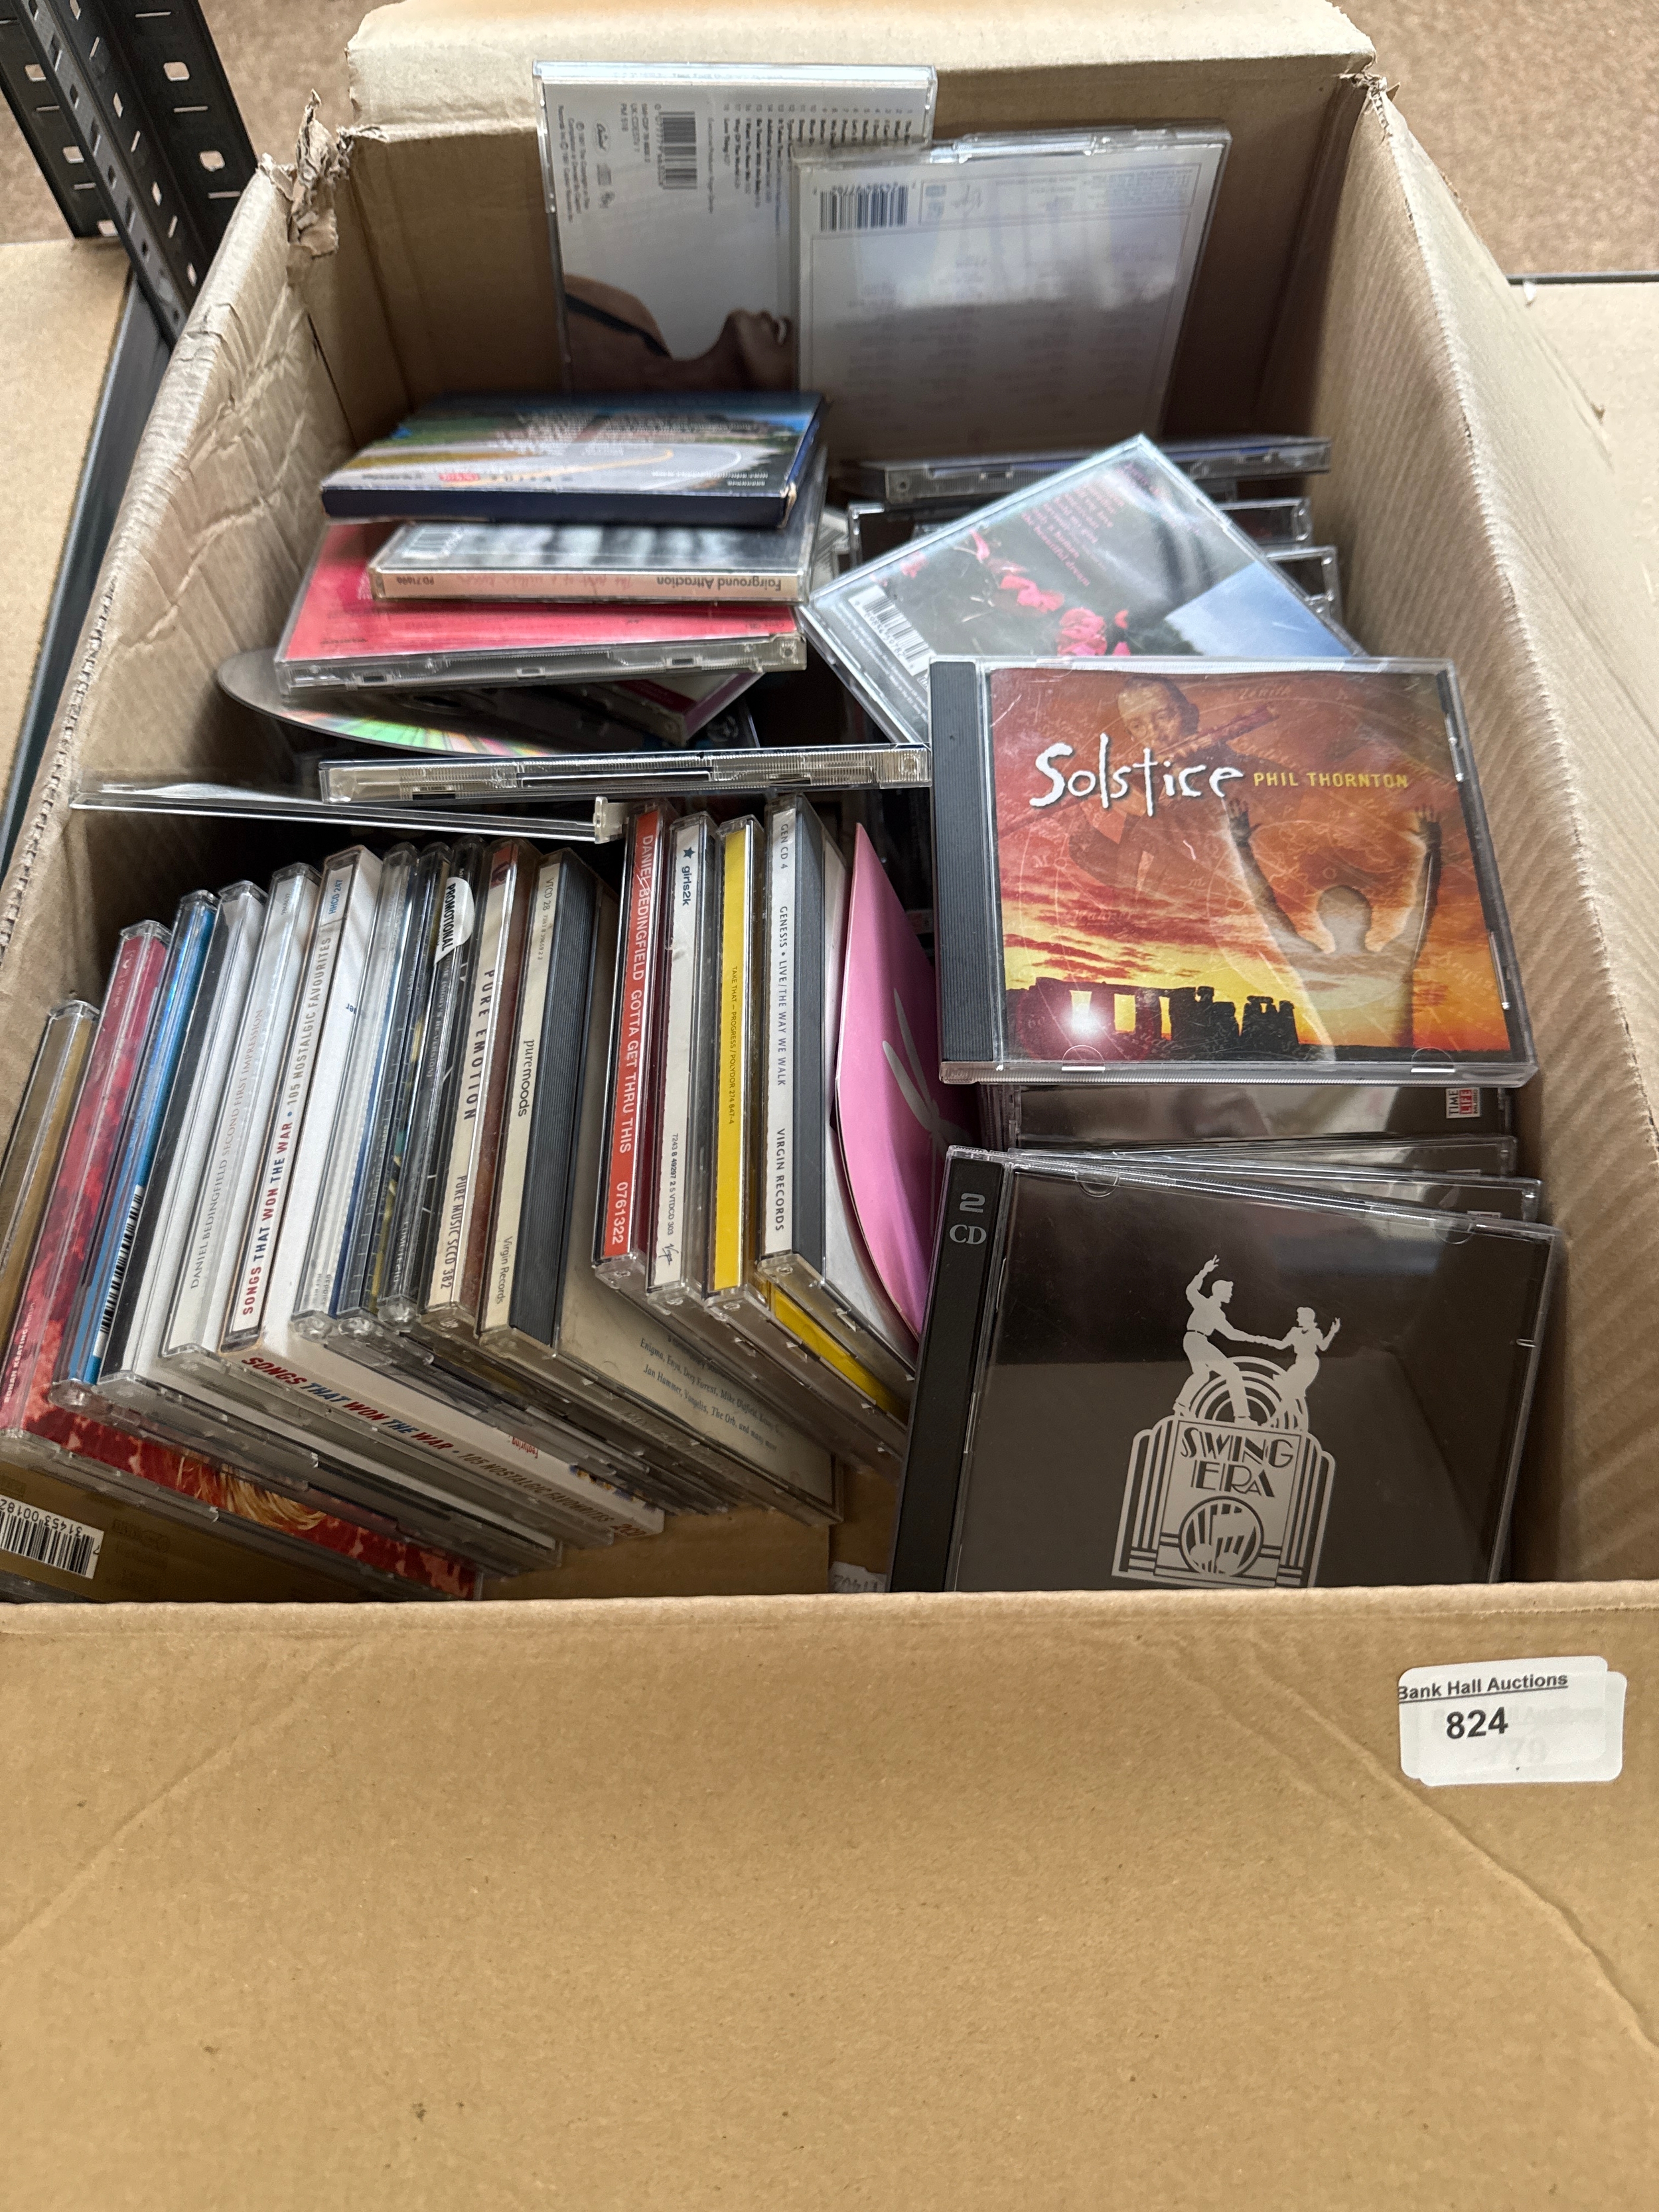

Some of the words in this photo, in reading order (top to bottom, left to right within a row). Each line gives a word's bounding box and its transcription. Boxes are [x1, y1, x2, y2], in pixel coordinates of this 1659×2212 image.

[656, 576, 713, 589] Attraction
[717, 575, 782, 591] Fairground
[1030, 732, 1245, 818] Solstice
[1254, 773, 1299, 787] PHIL
[1306, 773, 1409, 788] THORNTON
[640, 834, 654, 881] DANIEL
[780, 847, 788, 859] CD
[328, 893, 340, 915] HHCD
[334, 879, 343, 893] 247
[543, 877, 555, 899] VTCD
[682, 865, 693, 906] girls2k
[441, 883, 456, 952] PROMOTIONAL
[543, 899, 551, 911] 28
[632, 888, 652, 981] BEDINGFIELD
[779, 906, 788, 948] GENESIS
[308, 937, 332, 1010] FAVOURITES
[478, 969, 496, 1017] PURE
[628, 989, 642, 1037] GOTTA
[778, 1011, 786, 1034] WAY
[293, 1011, 316, 1080] NOSTALGIC
[626, 1039, 639, 1068] GET
[778, 1037, 786, 1053] WE
[464, 1029, 488, 1120] EMOTION
[518, 1039, 536, 1118] puremoods
[777, 1057, 786, 1086] WALK
[287, 1083, 301, 1106] 105
[622, 1072, 636, 1114] THRU
[1448, 1090, 1459, 1116] TIME
[1461, 1090, 1472, 1113] LIFE
[190, 1241, 208, 1290] DANIEL
[202, 1159, 228, 1240] BEDINGFIELD
[222, 1108, 240, 1156] SECOND
[234, 1077, 248, 1107] FIRST
[242, 1009, 263, 1074] IMPRESSION
[276, 1122, 293, 1155] WAR
[619, 1117, 634, 1153] THIS
[776, 1128, 786, 1171] VIRGIN
[269, 1157, 285, 1184] THE
[454, 1175, 467, 1201] PURE
[261, 1187, 279, 1222] WON
[449, 1203, 465, 1237] MUSIC
[612, 1181, 628, 1246] 0761322
[775, 1174, 785, 1231] RECORDS
[959, 1193, 985, 1213] 2
[253, 1226, 270, 1262] THAT
[500, 1235, 513, 1265] Virgin
[949, 1224, 987, 1245] CD
[243, 1266, 262, 1315] SONGS
[439, 1268, 455, 1290] 382
[496, 1266, 509, 1305] Records
[13, 1328, 29, 1368] KEATING
[640, 1337, 665, 1362] Enigma,
[666, 1354, 682, 1374] Enya,
[643, 1364, 656, 1378] Jan
[657, 1370, 683, 1397] Hammer,
[684, 1389, 709, 1414] Vangelis,
[711, 1406, 724, 1420] The
[725, 1414, 737, 1428] Orb,
[241, 1357, 308, 1385] SONGS
[299, 1382, 353, 1403] THAT
[342, 1401, 390, 1422] WON
[381, 1418, 419, 1434] THE
[411, 1432, 455, 1451] WAR
[458, 1452, 489, 1466] 105
[481, 1463, 552, 1495] NOSTALGIC
[545, 1491, 615, 1523] FAVOURITES
[1180, 1427, 1294, 1468] SWING
[1190, 1459, 1275, 1498] ERA
[0, 1499, 40, 1522] 00182
[44, 1514, 83, 1538] 31453
[1398, 1682, 1441, 1700] Bank
[1447, 1678, 1482, 1696] Hall
[1487, 1674, 1569, 1692] Auctions
[1445, 1706, 1510, 1740] 824
